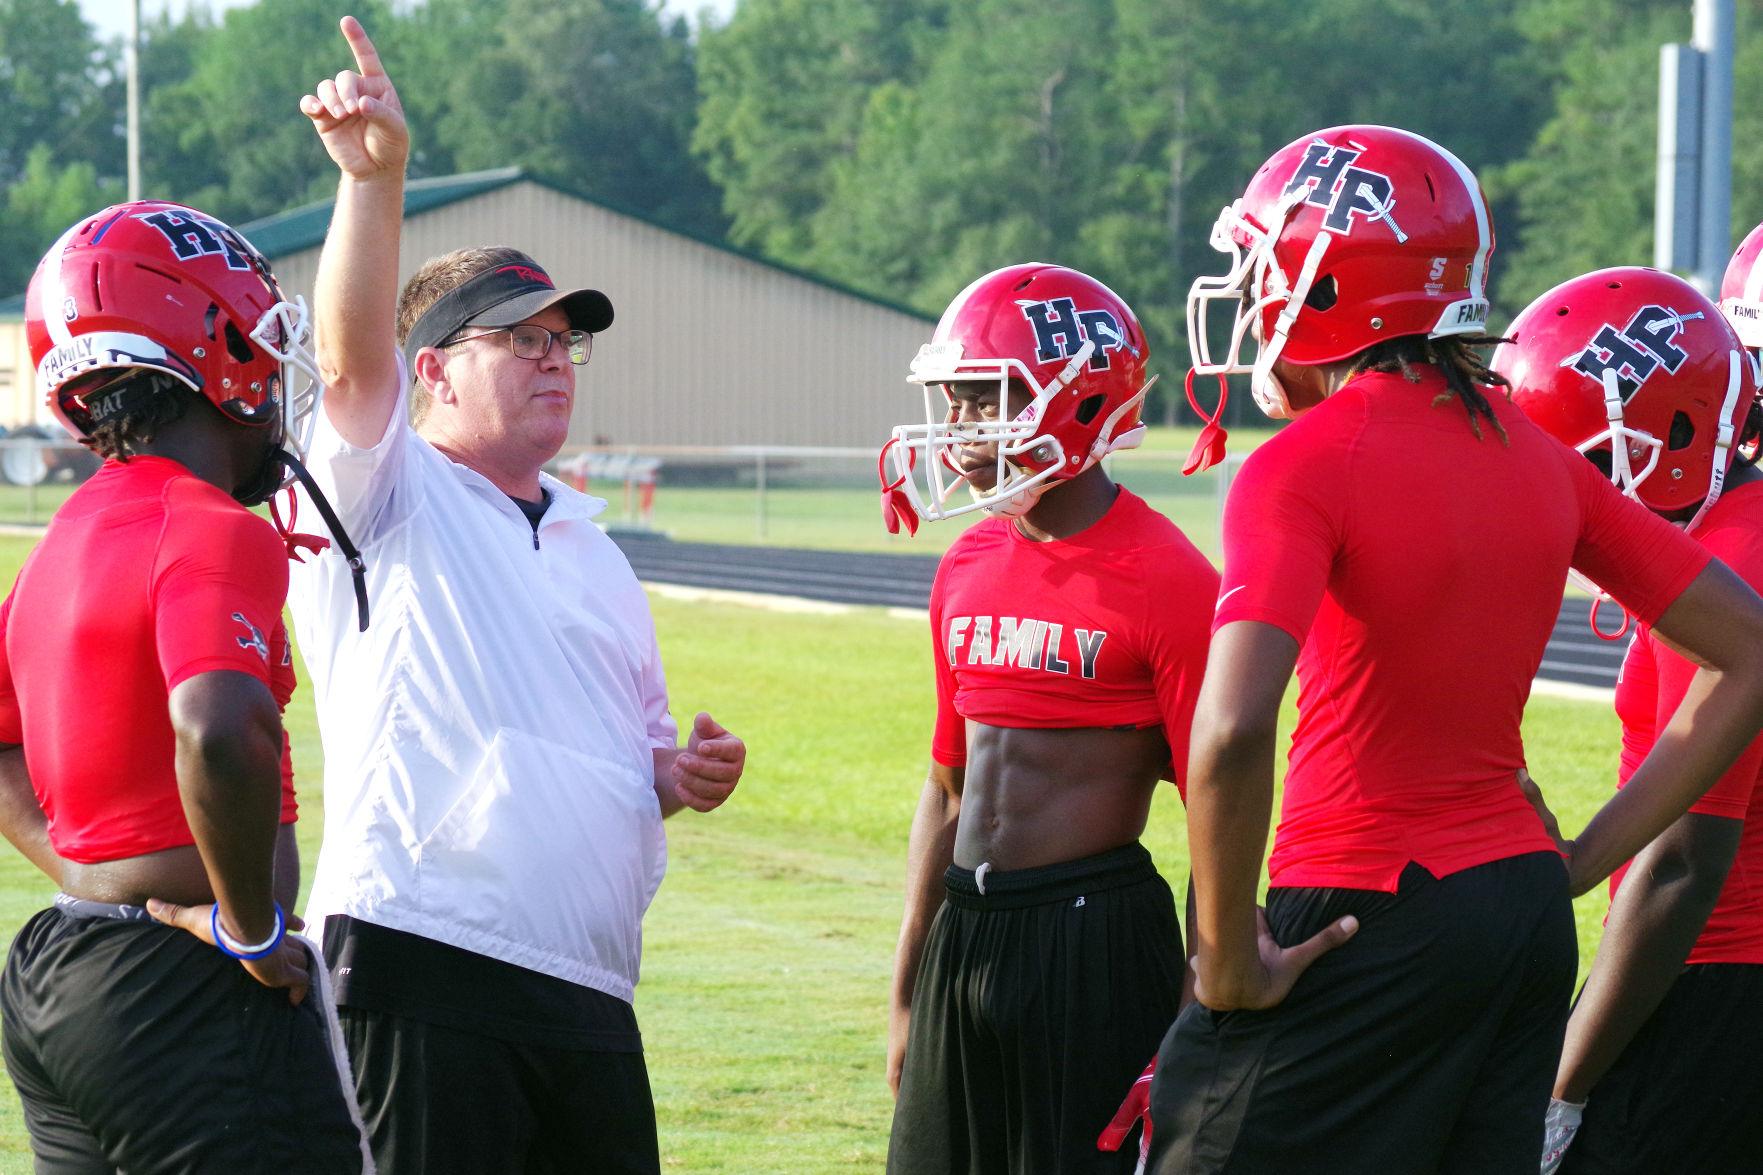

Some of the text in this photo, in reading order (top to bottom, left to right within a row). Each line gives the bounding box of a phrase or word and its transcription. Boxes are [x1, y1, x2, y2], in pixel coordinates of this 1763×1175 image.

[1279, 142, 1395, 237] HP
[44, 336, 93, 377] FAMILY
[1020, 297, 1121, 373] HP
[1570, 304, 1689, 407] HP
[949, 616, 1107, 679] FAMILY
